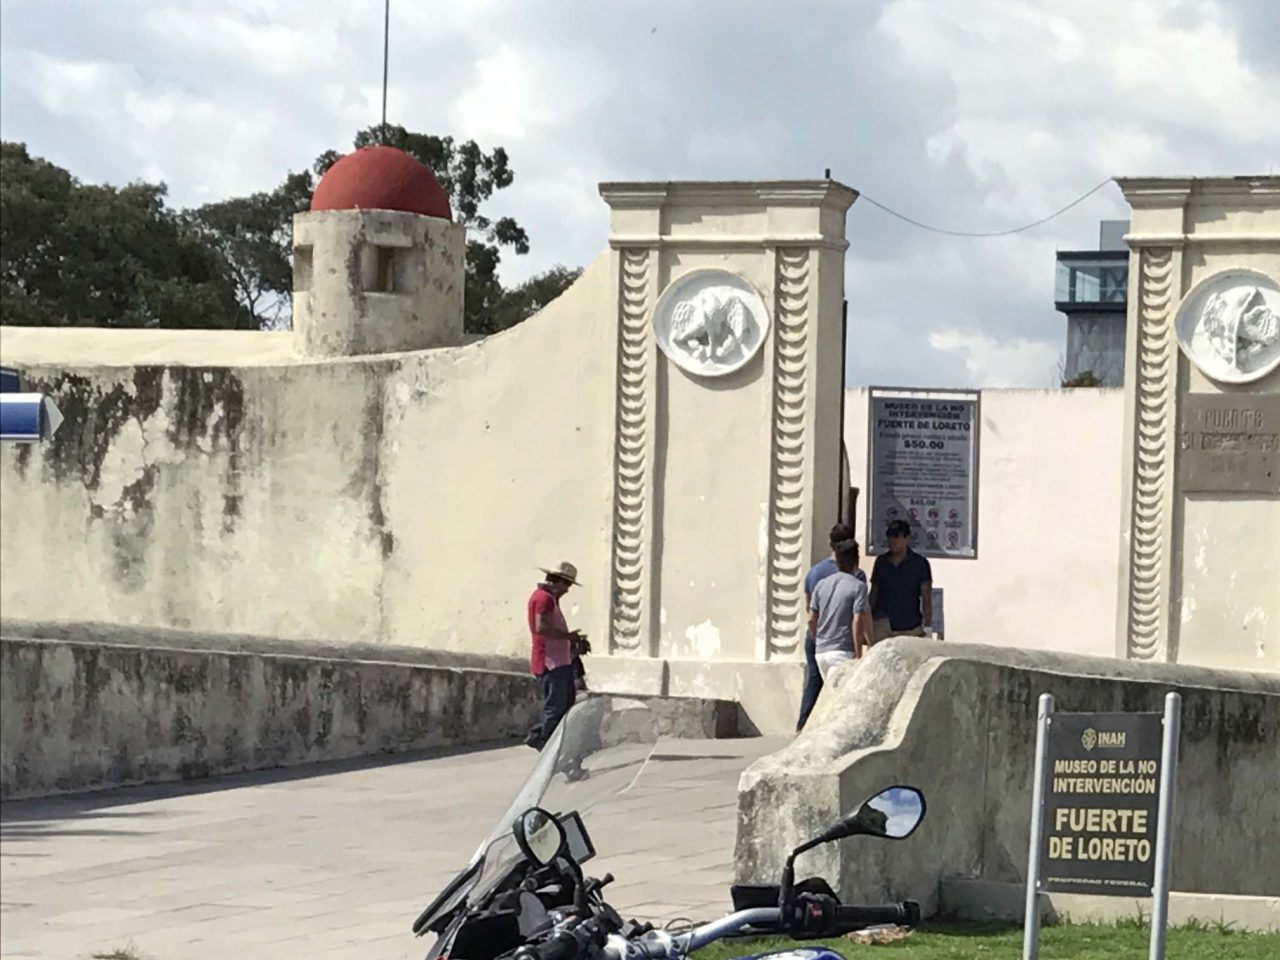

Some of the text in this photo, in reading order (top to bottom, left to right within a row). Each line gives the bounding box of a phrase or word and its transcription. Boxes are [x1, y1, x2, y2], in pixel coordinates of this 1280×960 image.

[878, 420, 971, 431] FUERTE DE LORETO
[904, 440, 944, 449] $50.00
[1098, 731, 1126, 746] INAH
[1054, 760, 1157, 775] MUSEO DE LA NO
[1053, 775, 1156, 794] INTERVENCIÓN
[1055, 808, 1148, 833] FUERTE
[1048, 836, 1151, 862] DE LORETO
